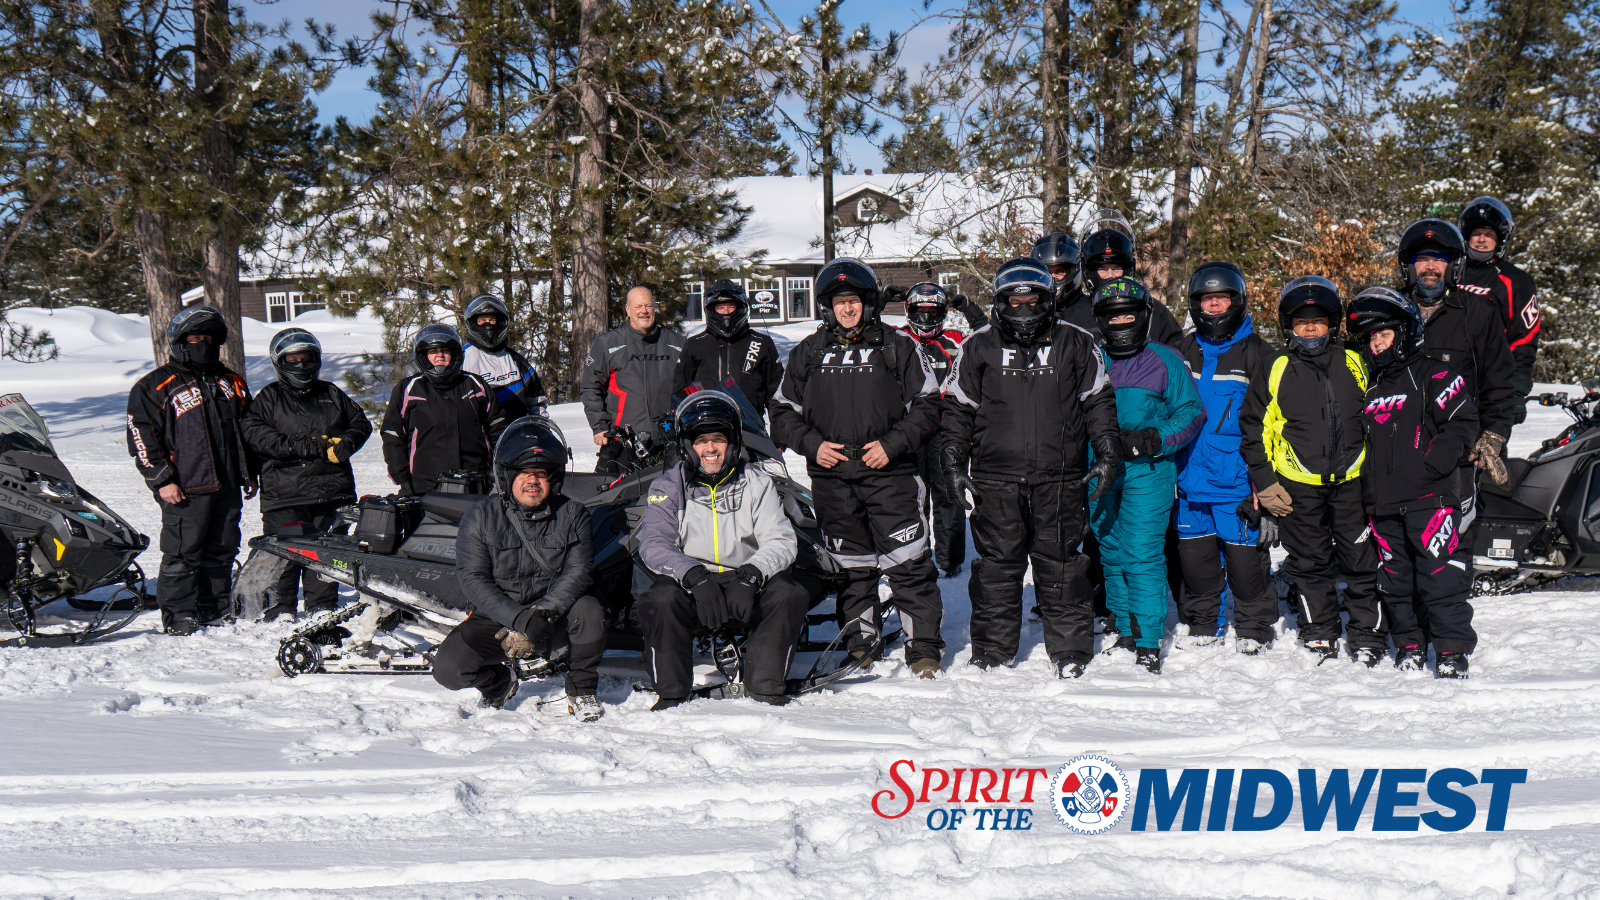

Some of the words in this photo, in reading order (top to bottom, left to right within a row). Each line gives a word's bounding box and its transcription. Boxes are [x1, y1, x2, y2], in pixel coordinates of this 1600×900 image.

[746, 341, 761, 361] FXR
[822, 349, 873, 364] FLY
[333, 558, 348, 569] TS4
[416, 571, 441, 580] 137
